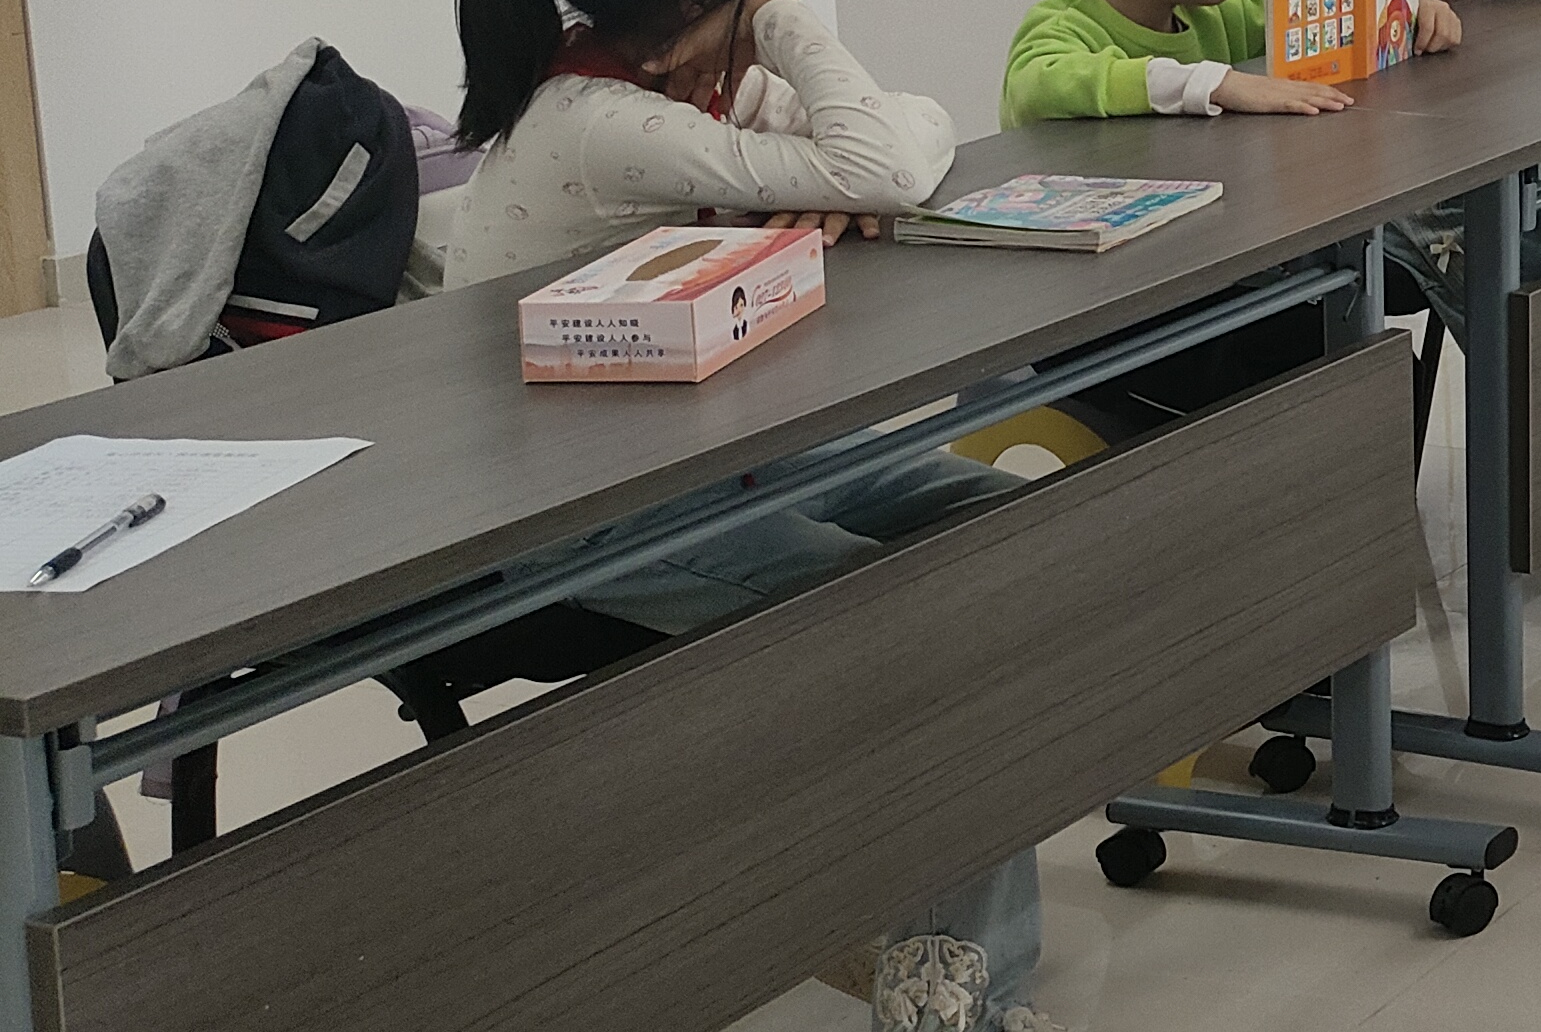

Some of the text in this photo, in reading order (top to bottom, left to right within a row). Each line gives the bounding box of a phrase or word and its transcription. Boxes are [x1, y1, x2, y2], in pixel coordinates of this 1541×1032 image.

[550, 319, 640, 328] 平安建设人人知晓
[562, 333, 652, 343] 平安建设人人参与
[576, 349, 666, 358] 平安成果人人共享
